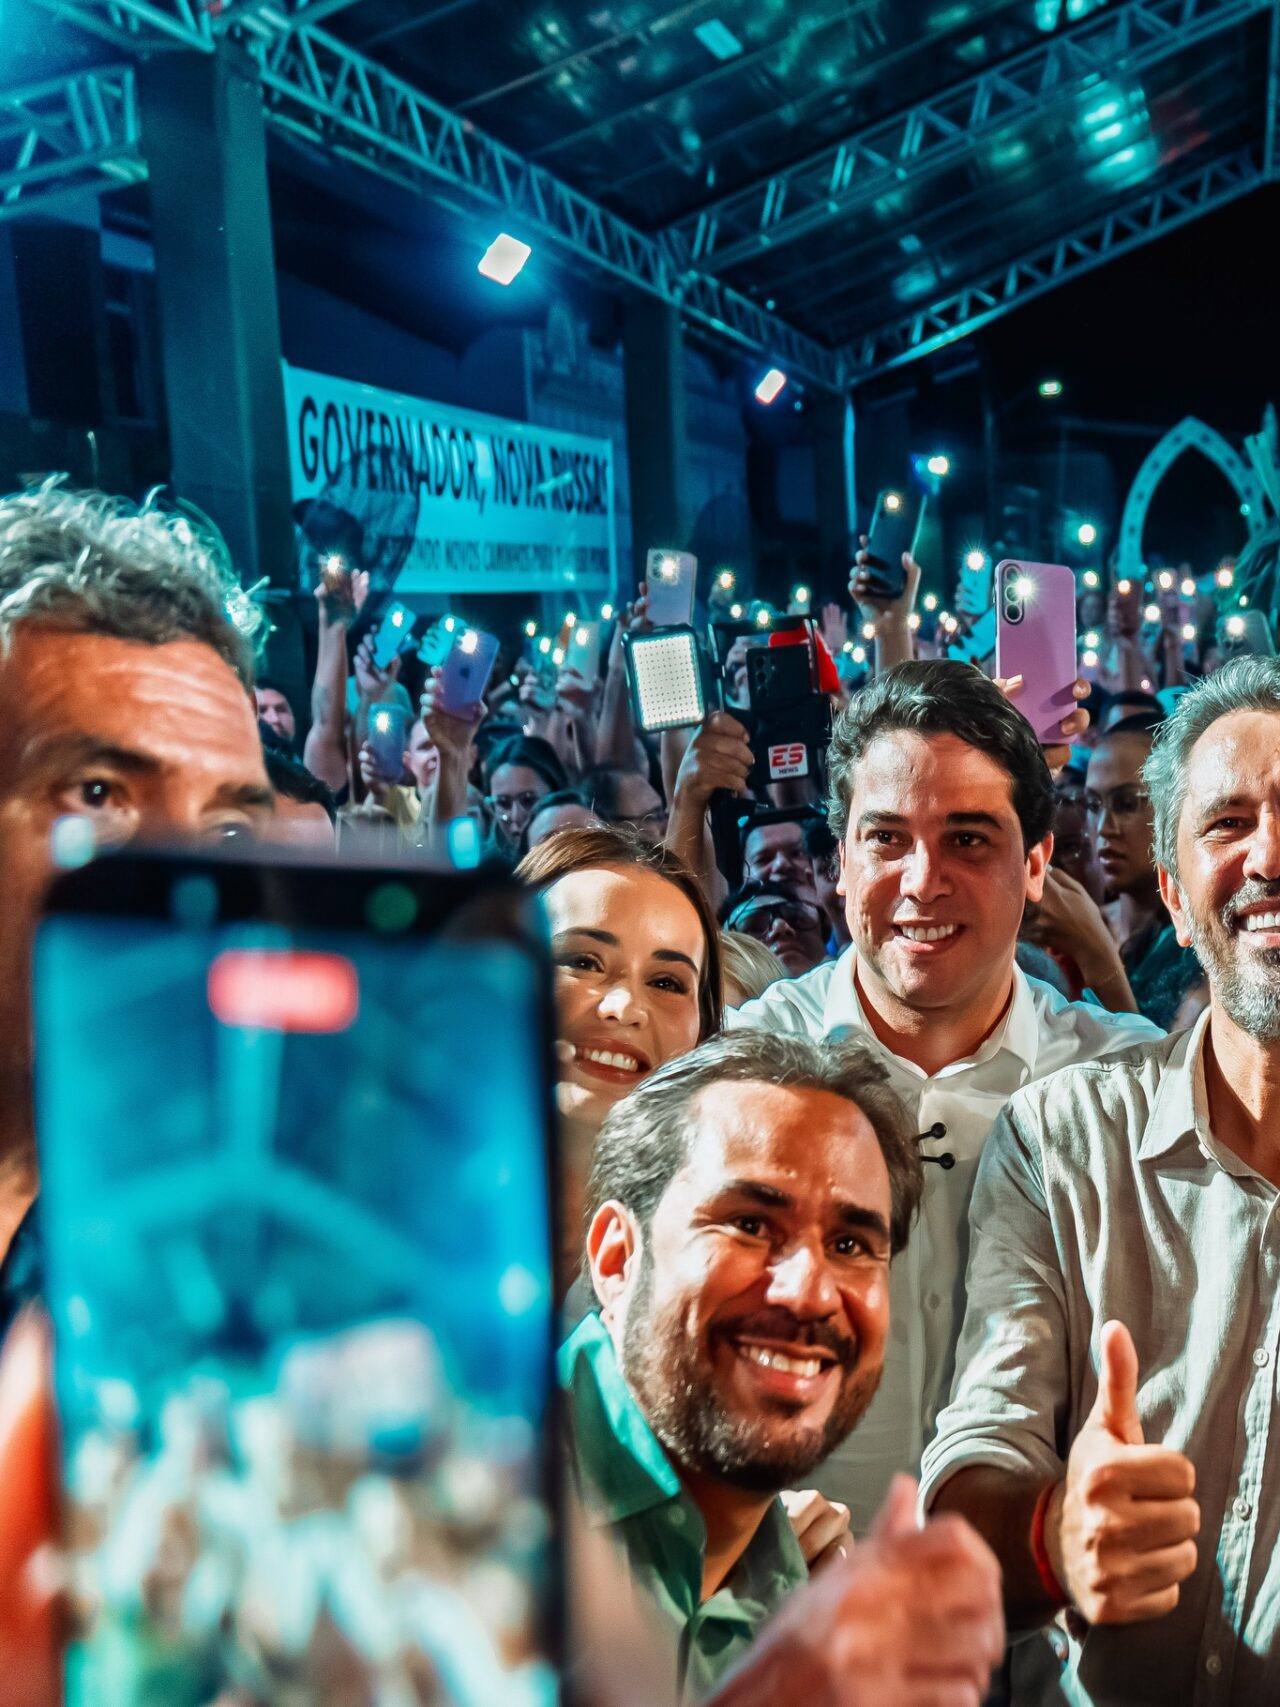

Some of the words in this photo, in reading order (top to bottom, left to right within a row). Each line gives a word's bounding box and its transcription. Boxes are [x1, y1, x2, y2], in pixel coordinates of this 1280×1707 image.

[300, 395, 487, 514] GOVERNADOR,
[490, 434, 547, 508] NOVA
[771, 744, 804, 767] ES
